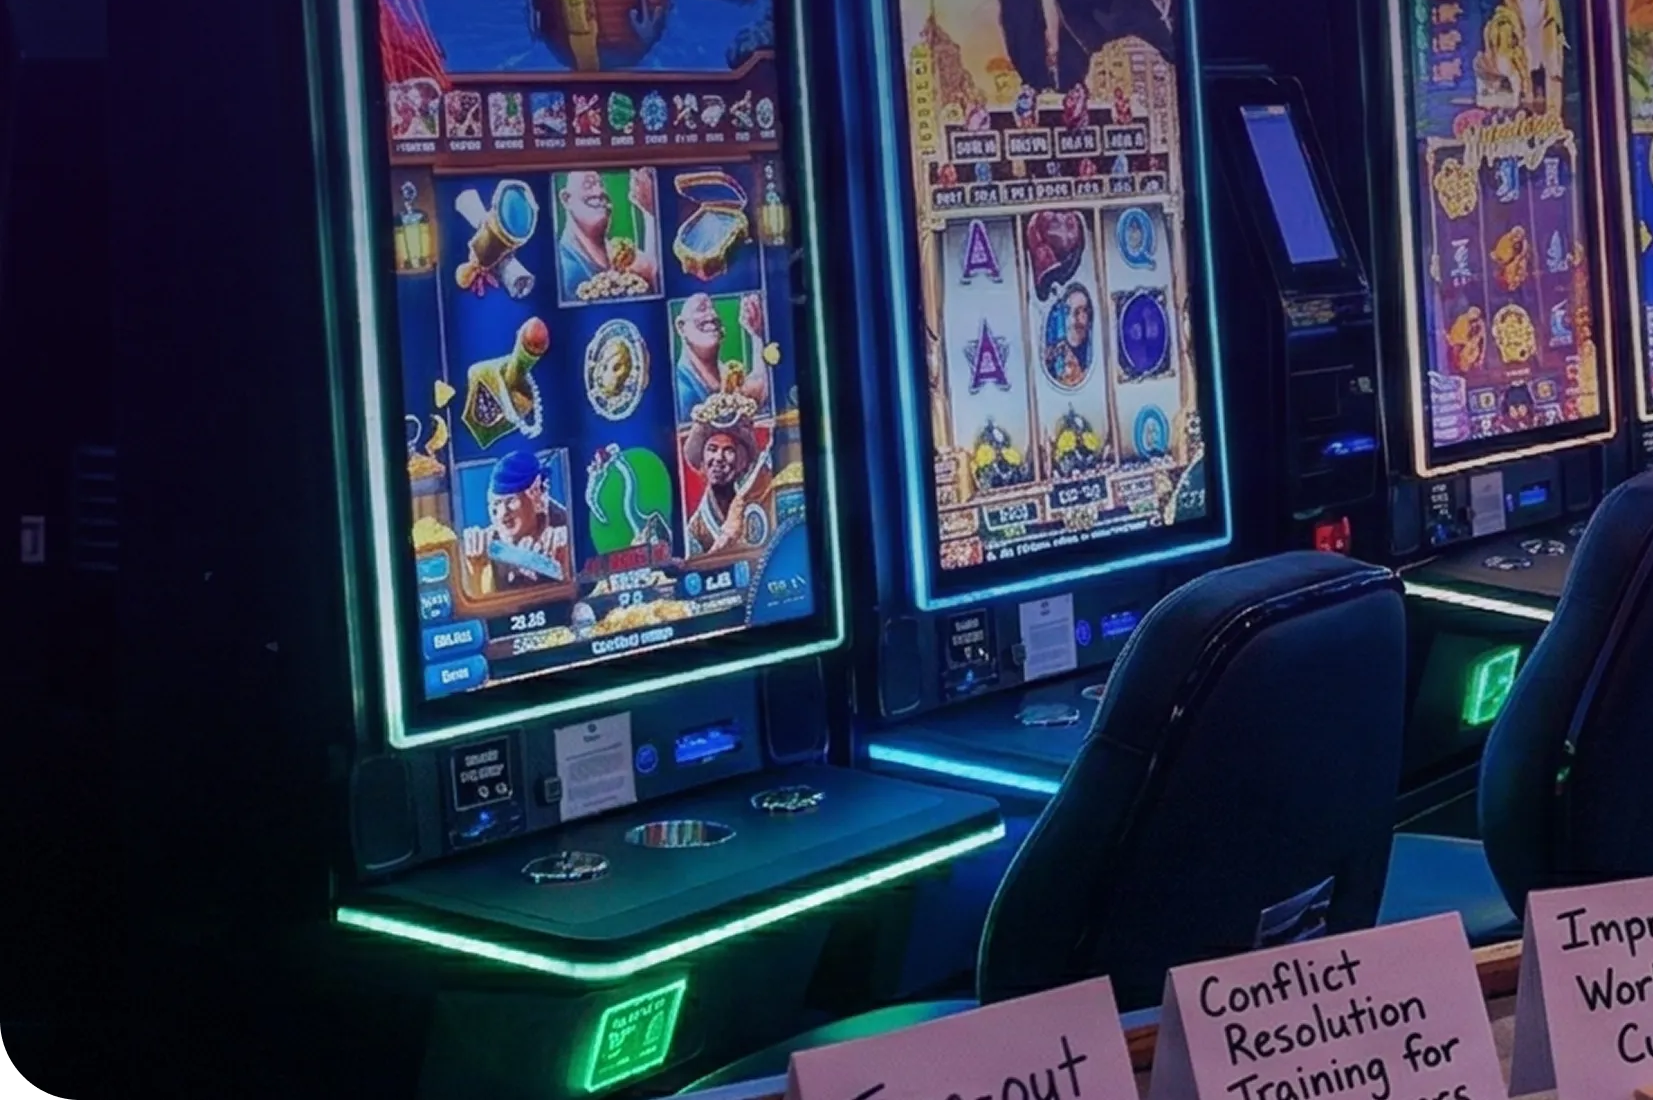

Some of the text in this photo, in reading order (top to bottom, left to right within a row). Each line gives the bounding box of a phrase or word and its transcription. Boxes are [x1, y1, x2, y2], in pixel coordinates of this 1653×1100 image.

[1201, 949, 1361, 1018] Conflict
[1225, 996, 1427, 1066] Resolution
[1227, 1032, 1461, 1100] Training for
